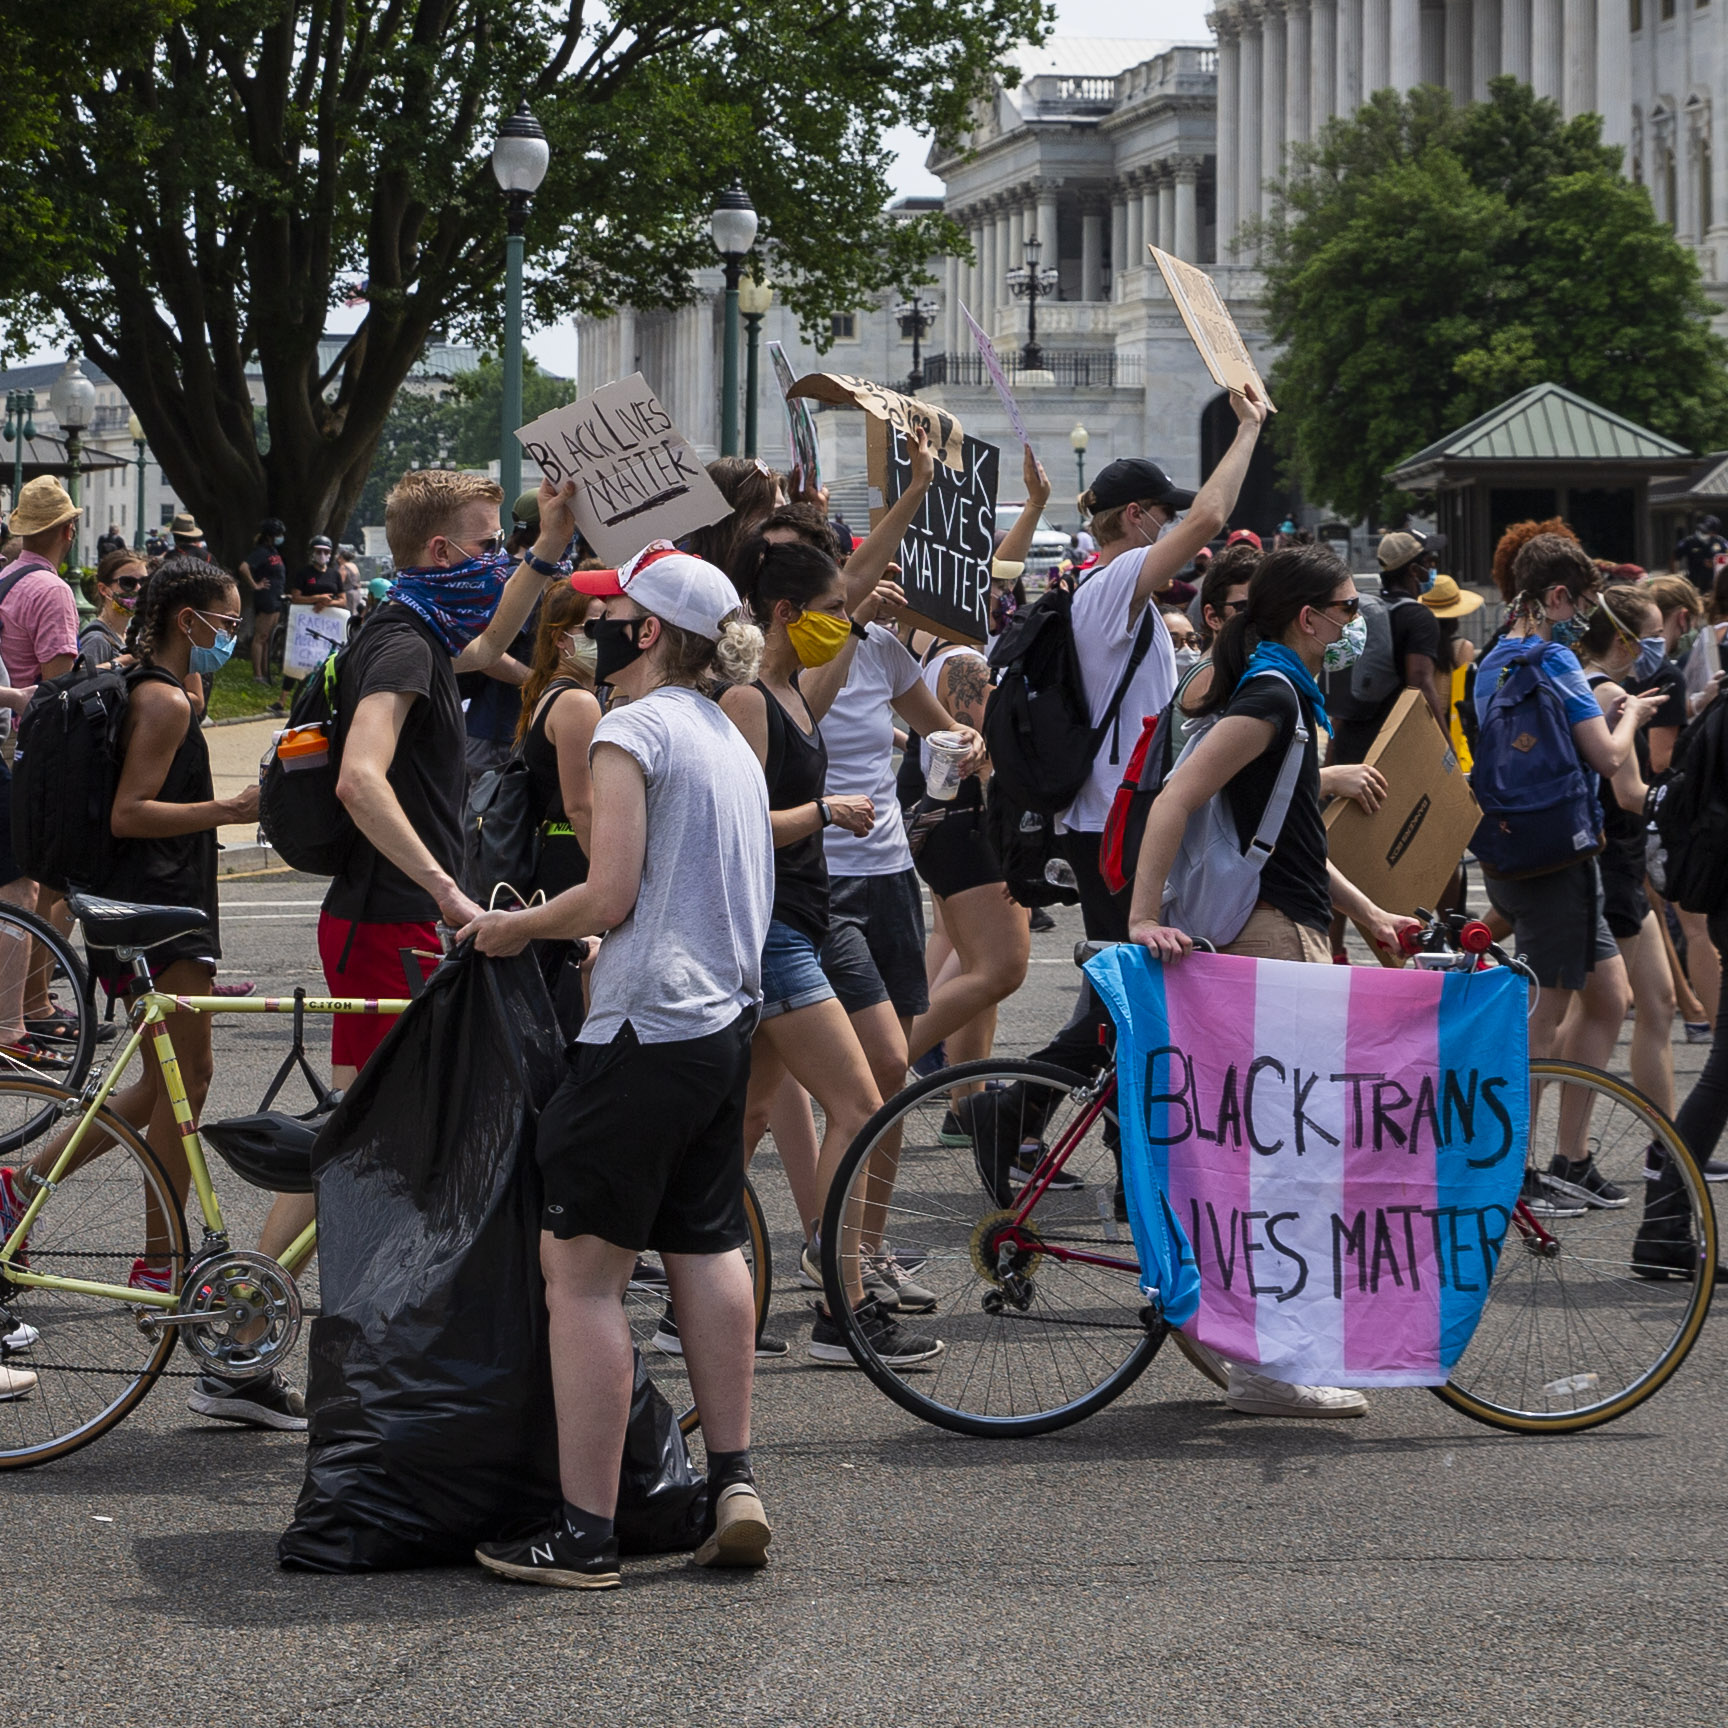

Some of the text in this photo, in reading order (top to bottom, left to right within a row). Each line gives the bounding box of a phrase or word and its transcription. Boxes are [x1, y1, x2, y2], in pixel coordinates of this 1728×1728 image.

[526, 398, 672, 485] BLACK LIVES
[581, 439, 700, 523] MATTER
[398, 592, 432, 622] NIRCA
[900, 537, 993, 640] MATTER
[554, 822, 575, 833] NIK
[1143, 1045, 1515, 1171] BLACK TRANS
[1330, 1203, 1511, 1300] MATTER
[530, 1542, 555, 1565] N
